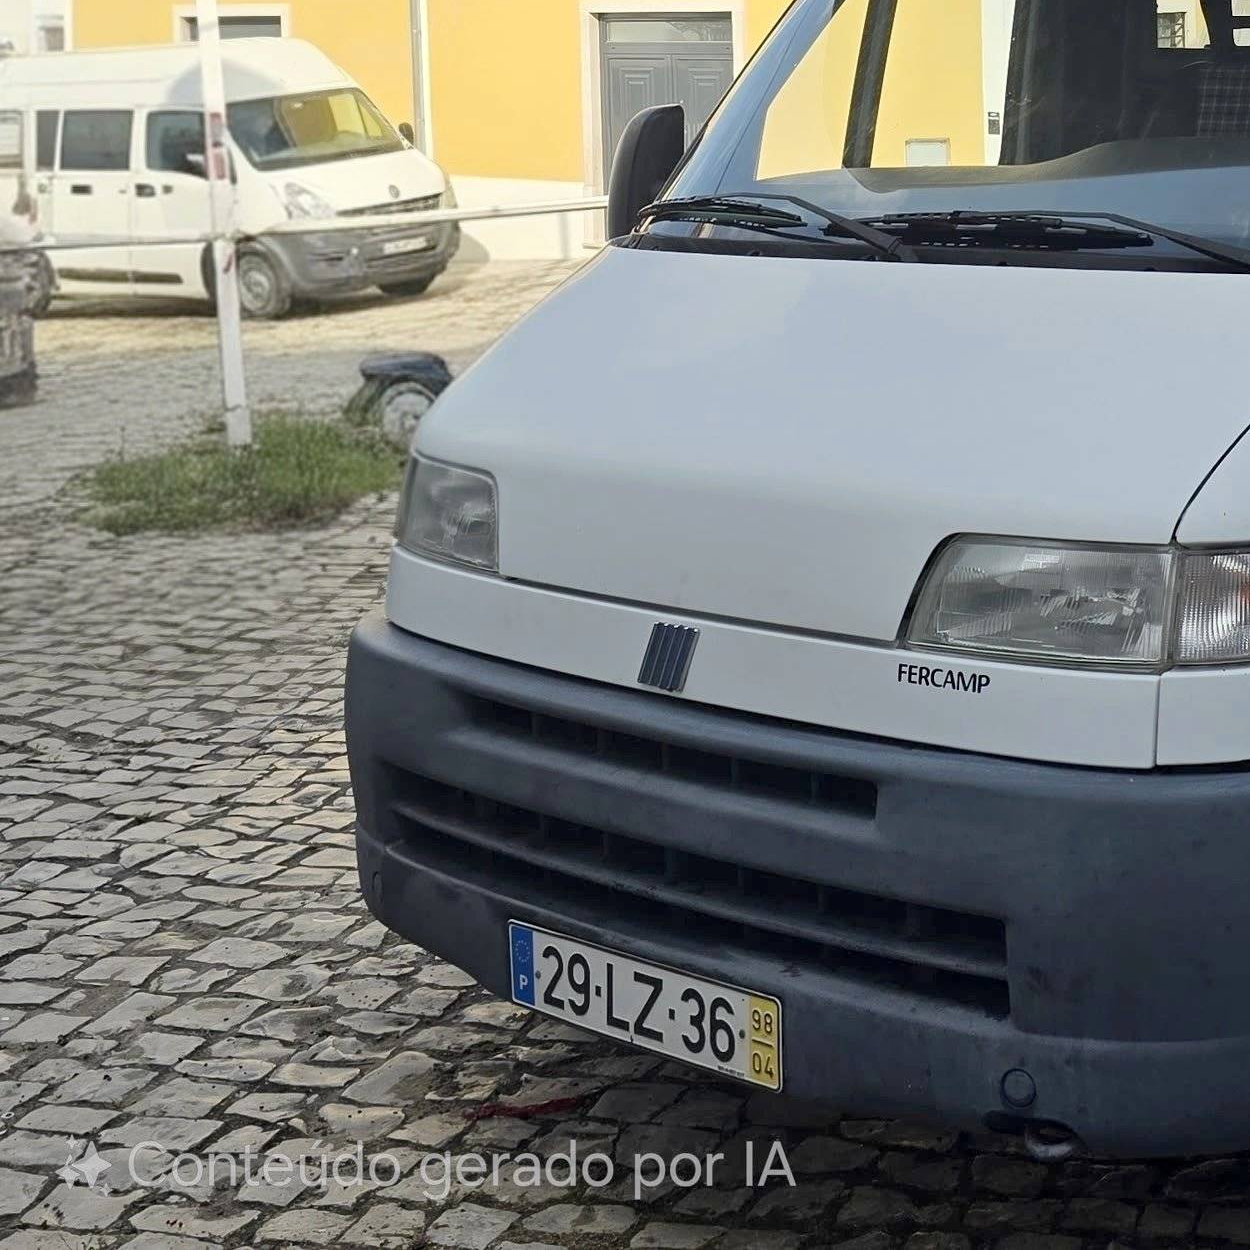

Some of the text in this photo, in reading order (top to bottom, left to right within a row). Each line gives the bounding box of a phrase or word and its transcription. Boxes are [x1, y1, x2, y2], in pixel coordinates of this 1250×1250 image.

[897, 663, 991, 694] FERCAMP
[518, 973, 529, 991] P
[751, 1008, 774, 1034] 98
[751, 1052, 775, 1079] 04
